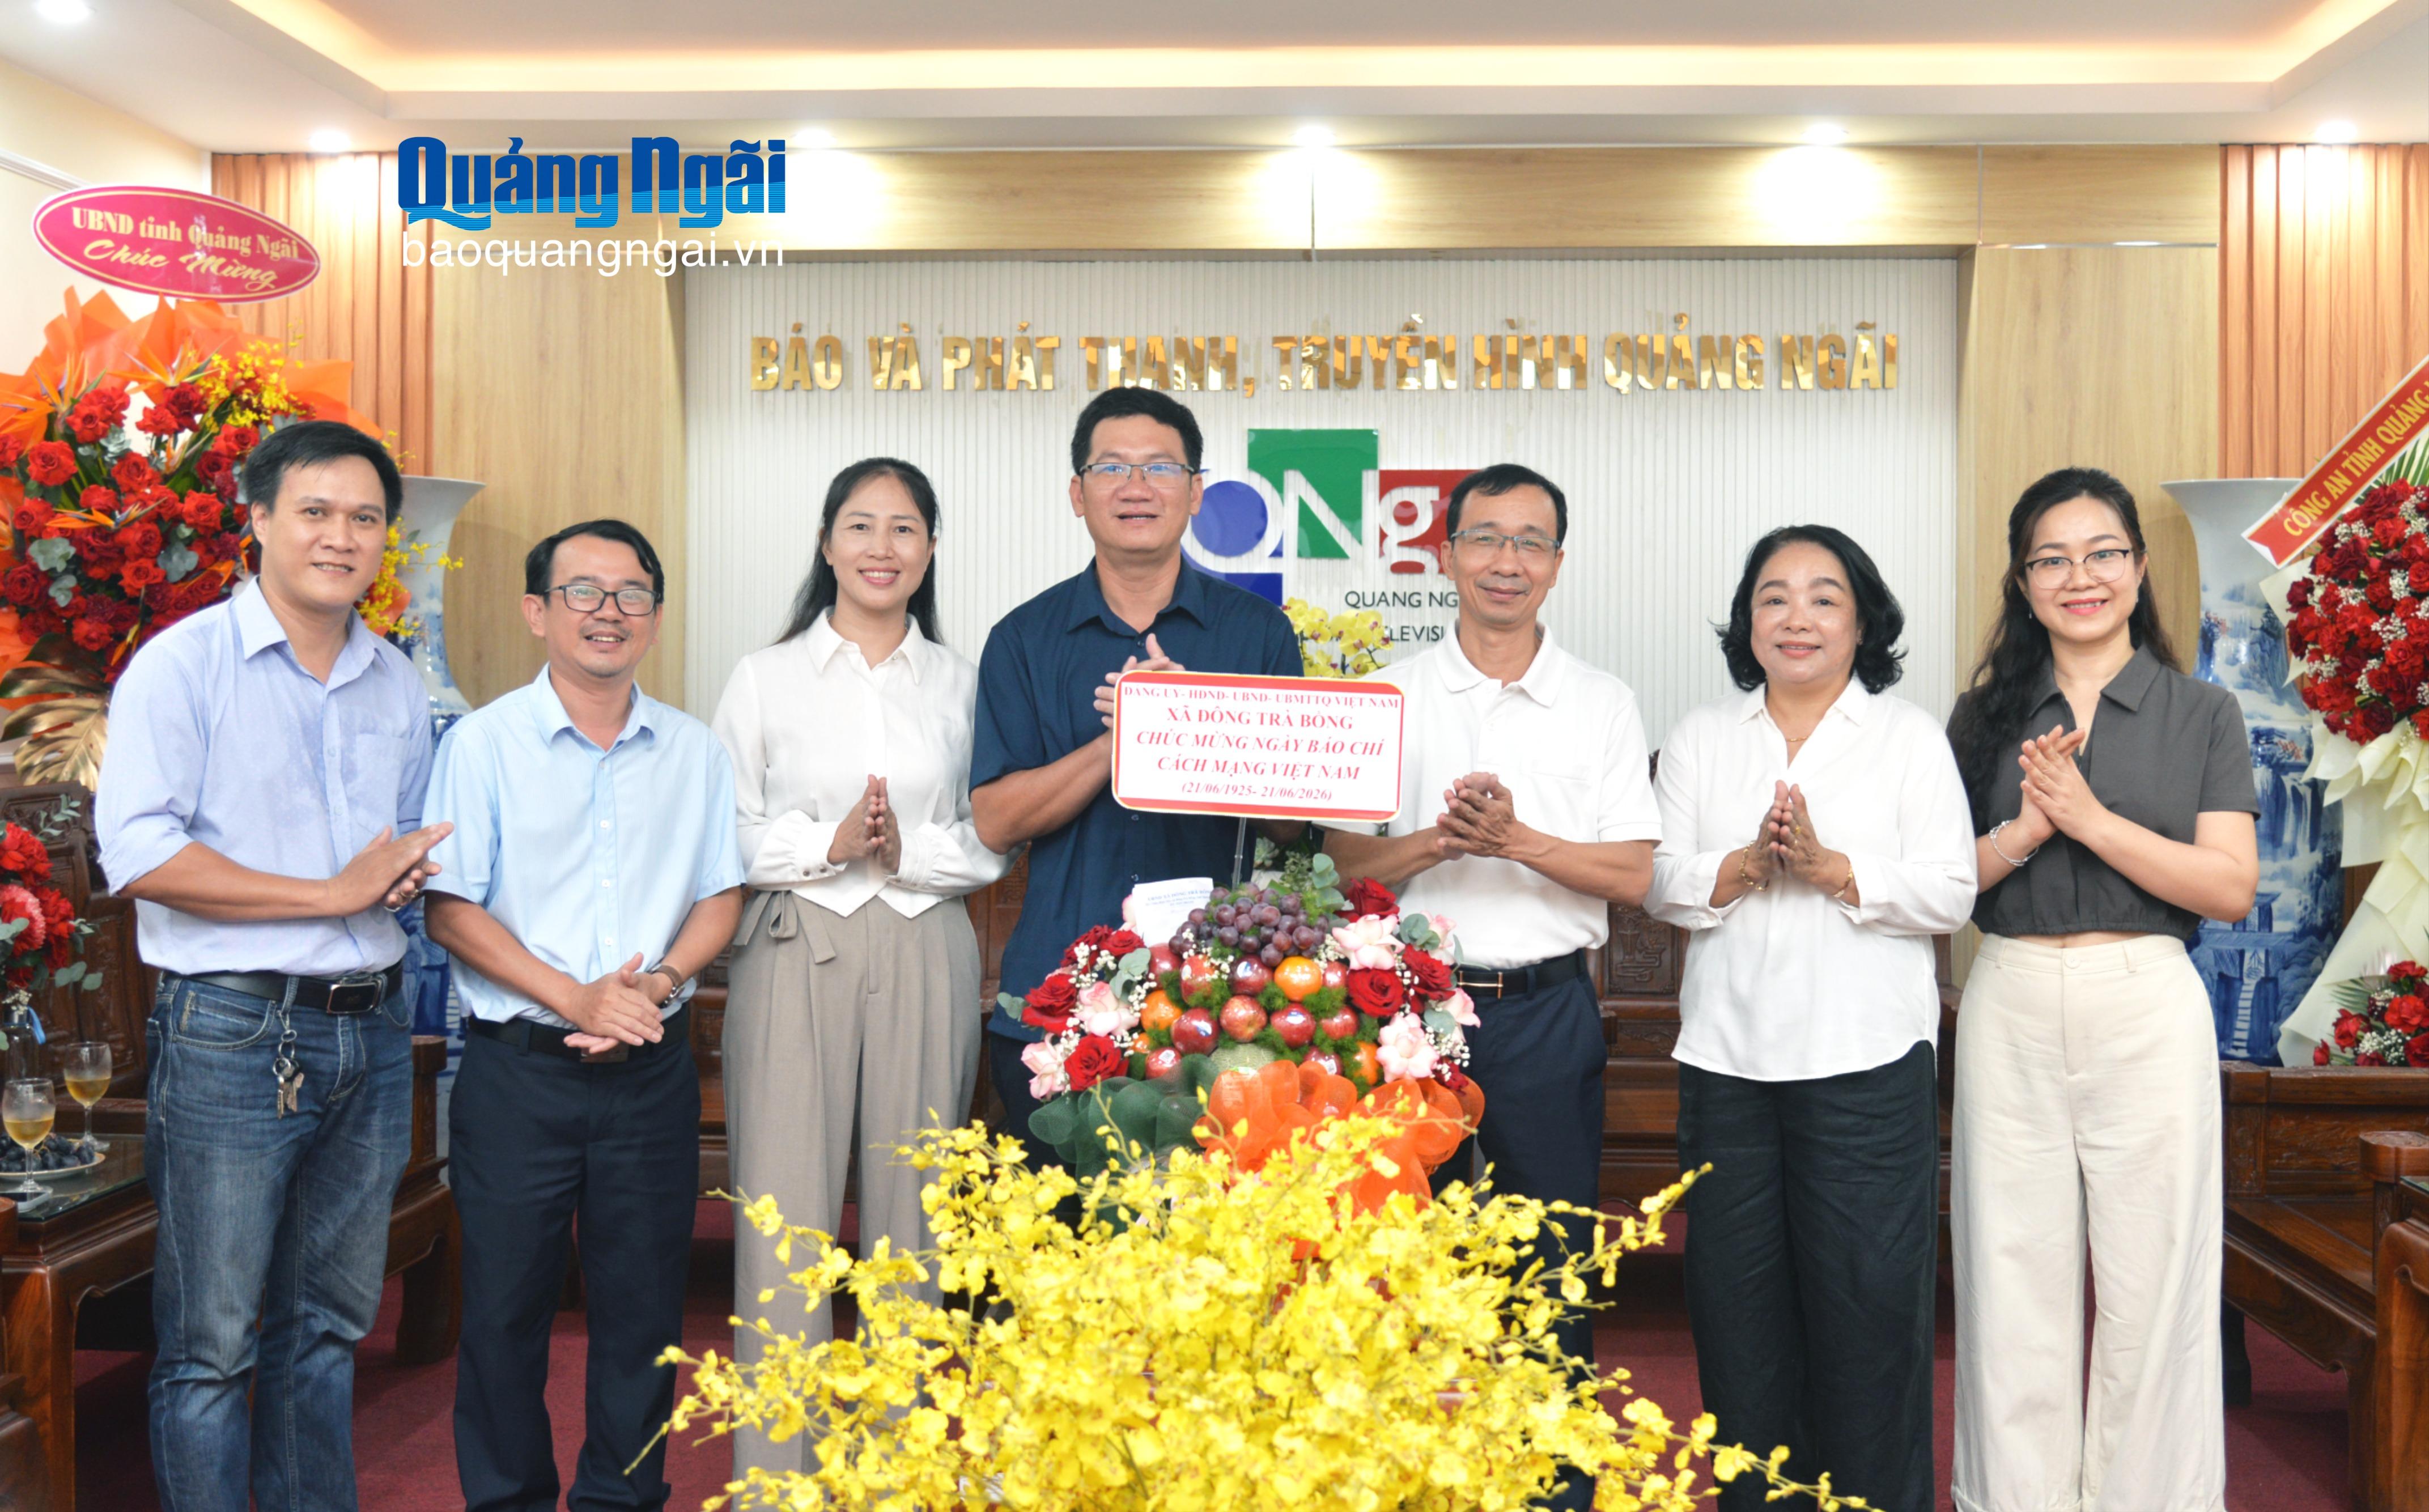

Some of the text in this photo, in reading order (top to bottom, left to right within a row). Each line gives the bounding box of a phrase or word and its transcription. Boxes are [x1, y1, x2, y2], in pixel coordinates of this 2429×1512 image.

[71, 206, 299, 261] UBND tỉnh Quảng Ngãi
[83, 239, 278, 291] Chúc Mừng
[751, 313, 1897, 398] BÁO VÀ PHÁT THANH, TRUYỀN HÌNH QUẢNG NGÃI
[2283, 389, 2429, 537] CÔNG AN TỈNH QUẢNG
[1344, 591, 1459, 609] QUANG NG
[1233, 691, 1272, 703] UBND-
[1276, 693, 1331, 707] UBMTTQ
[1369, 698, 1398, 708] NAM
[1167, 705, 1191, 722] XÃ
[1198, 706, 1251, 725] ĐÔNG
[1257, 709, 1294, 727] TRÀ
[1136, 728, 1385, 756] CHÚC MỪNG NGÀY BÁO CHÍ
[1157, 753, 1361, 780] CÁCH MẠNG VIỆT NAM
[1182, 782, 1333, 801] (21/06/1925- 21/06/2026)
